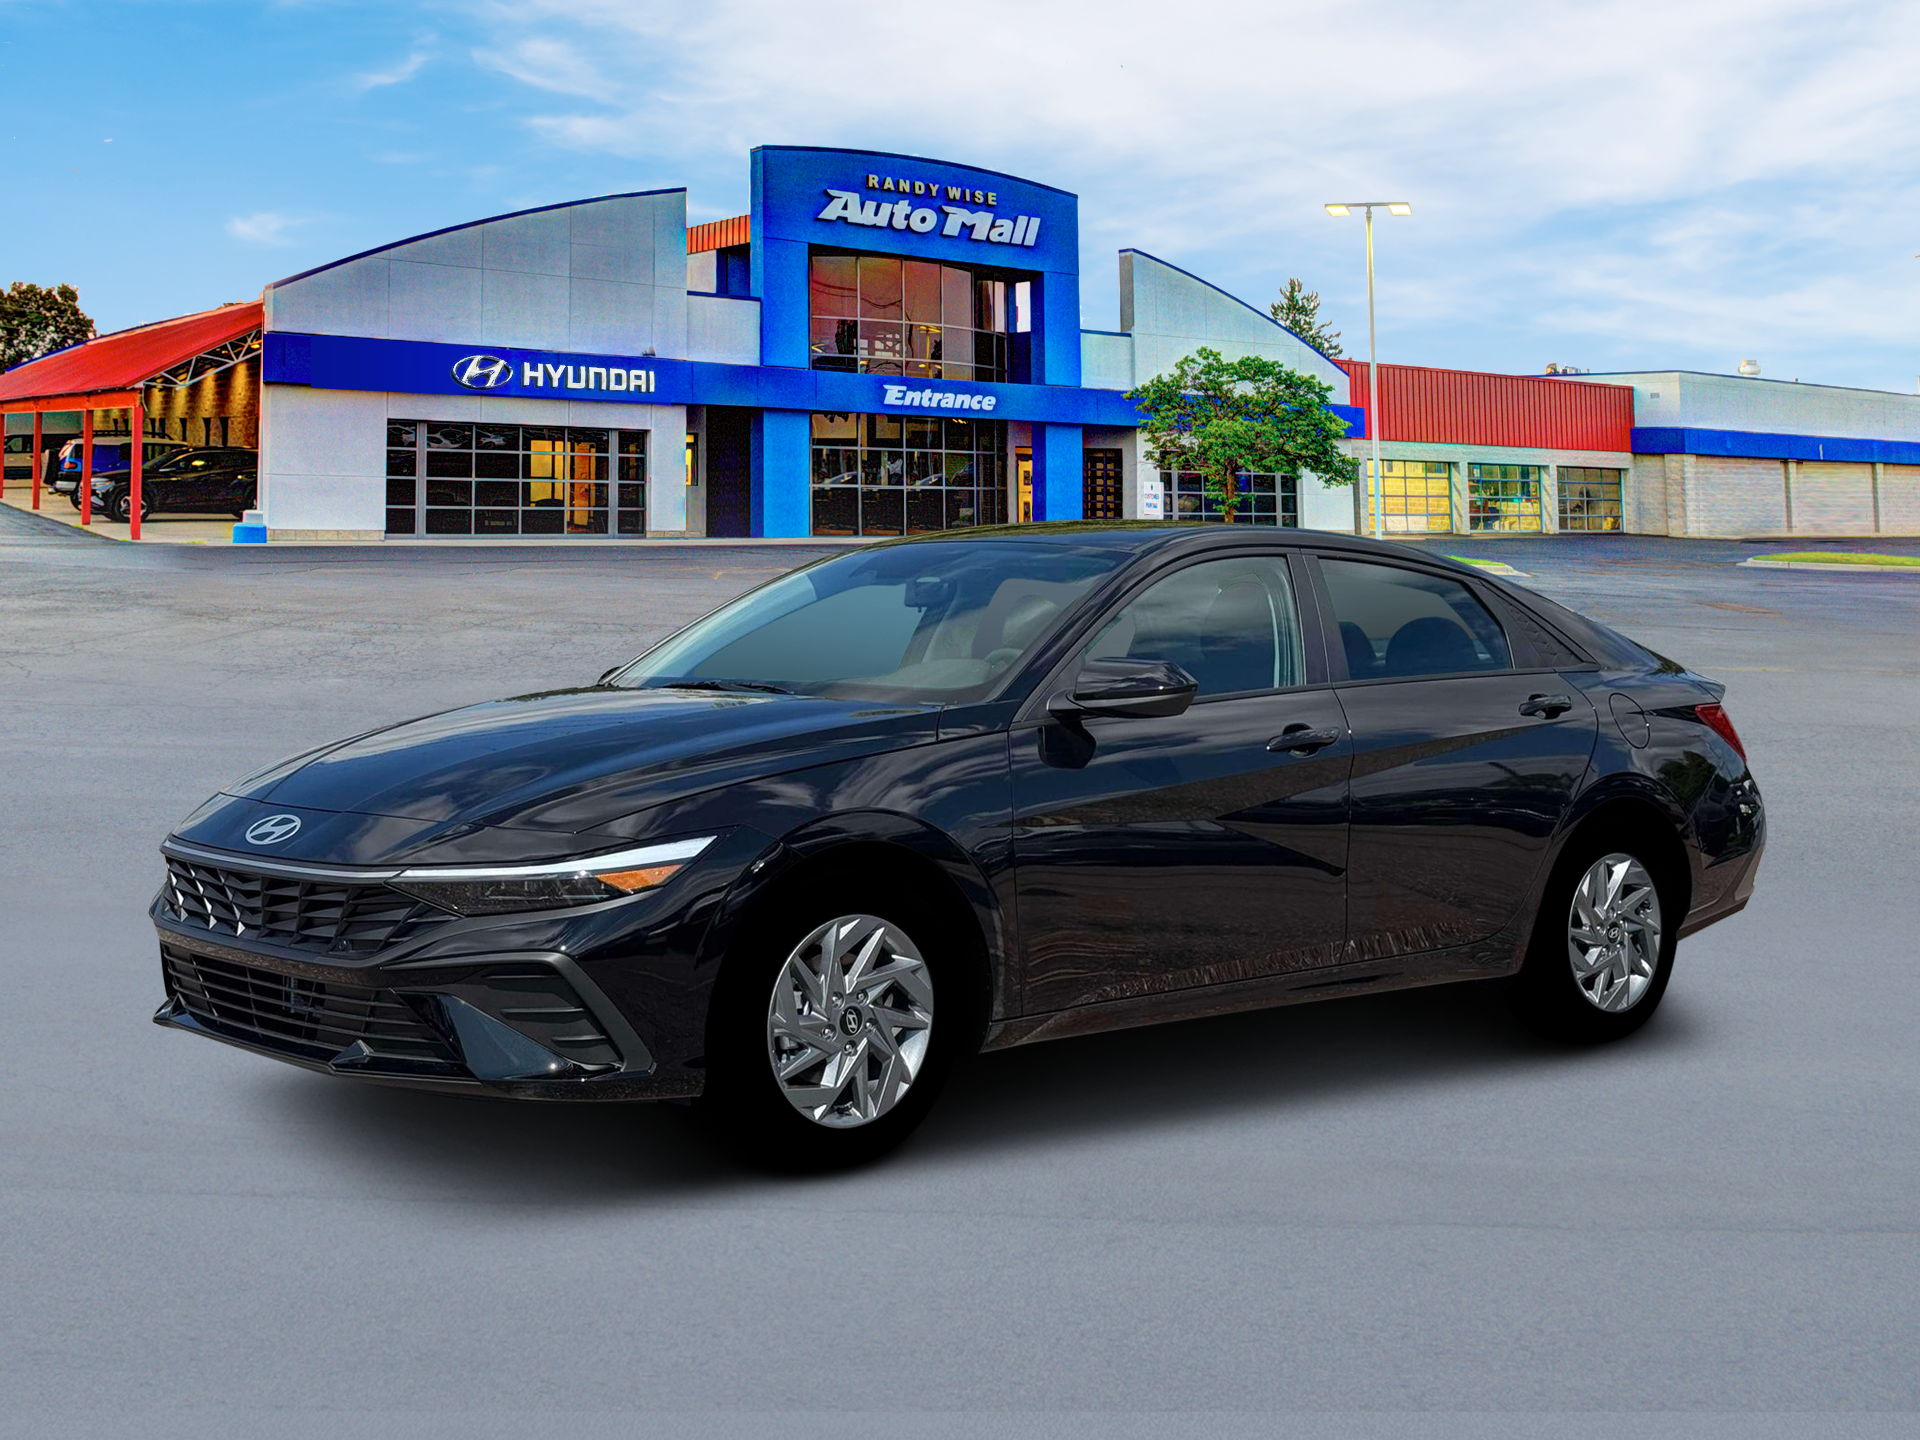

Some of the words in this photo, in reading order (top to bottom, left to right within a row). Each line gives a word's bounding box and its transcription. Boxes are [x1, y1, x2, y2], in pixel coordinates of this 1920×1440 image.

[867, 173, 939, 197] RANDY
[946, 186, 998, 206] WISE
[816, 188, 938, 233] Auto
[941, 205, 1041, 246] Mall
[522, 361, 656, 393] HYUNDAI
[883, 384, 997, 411] Entrance
